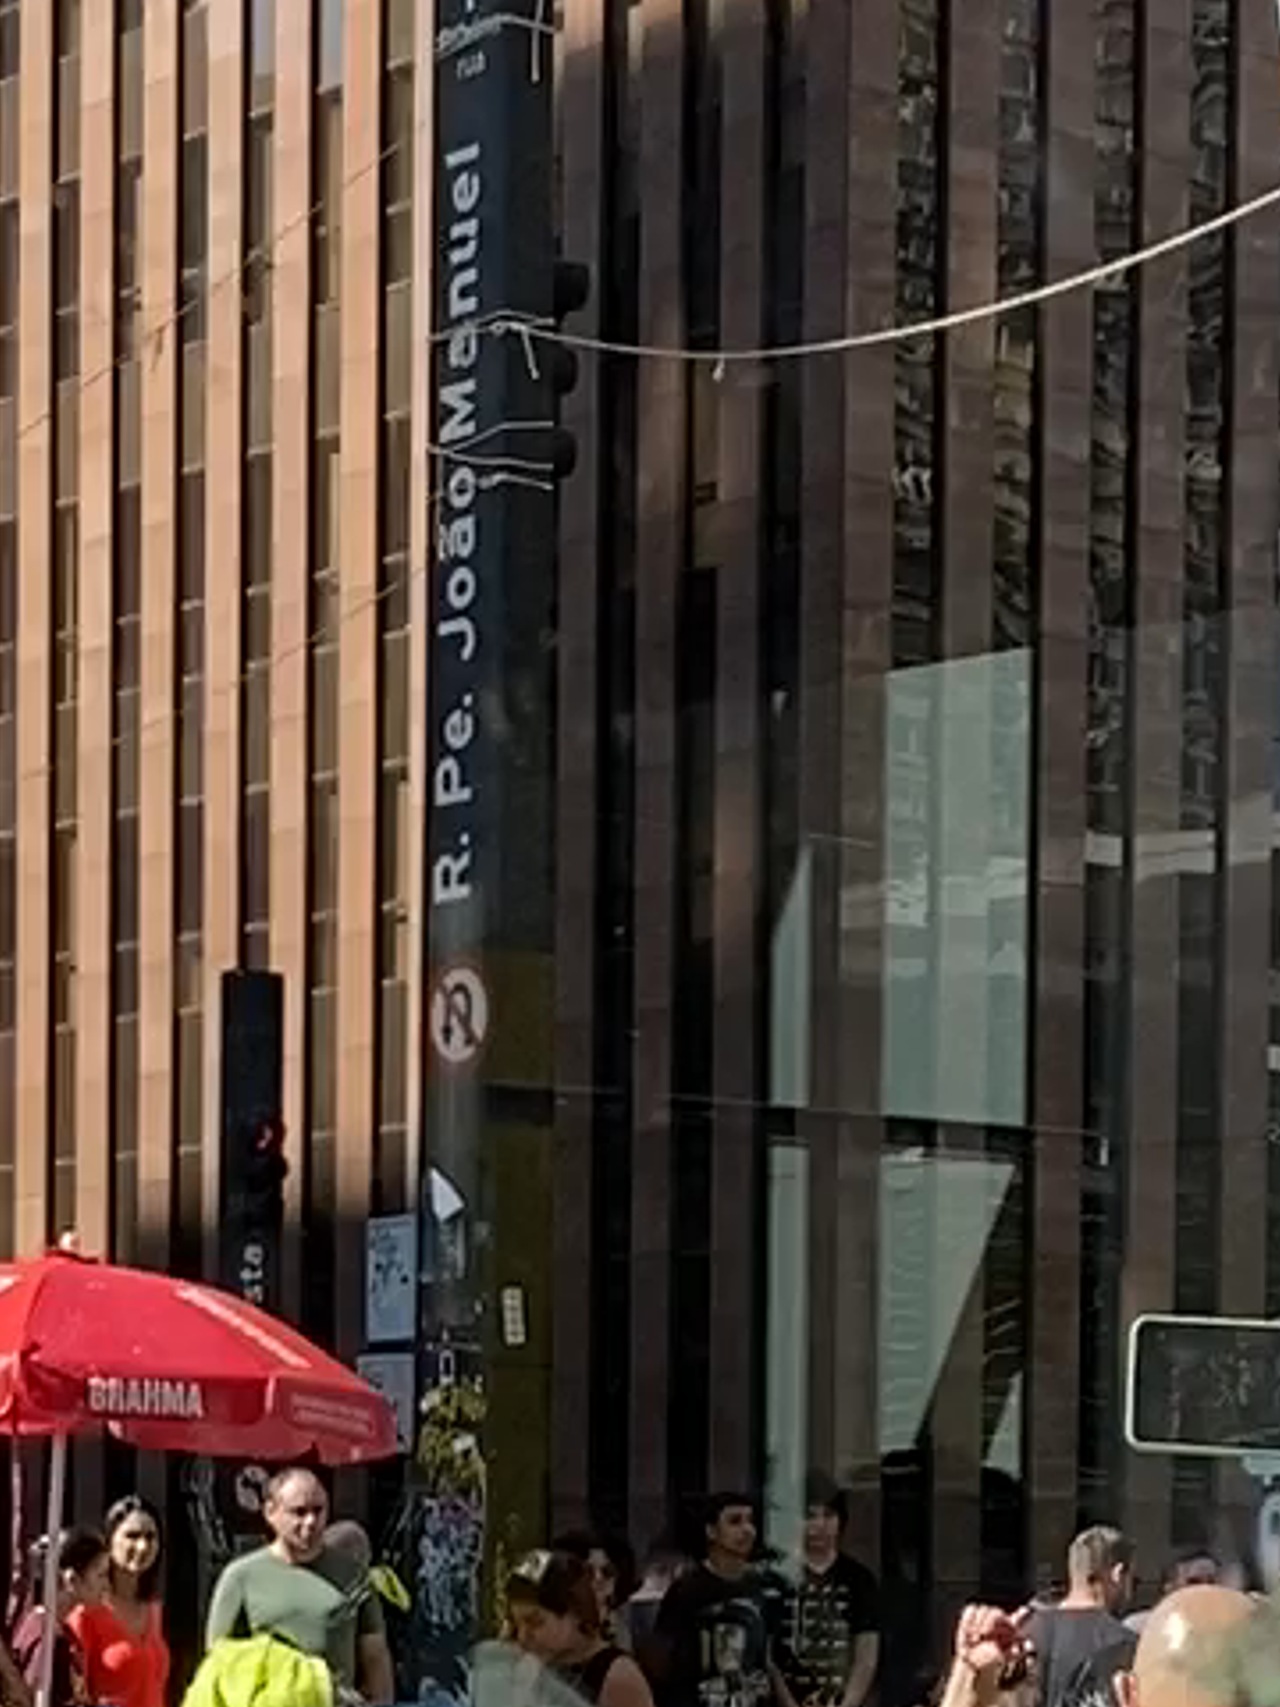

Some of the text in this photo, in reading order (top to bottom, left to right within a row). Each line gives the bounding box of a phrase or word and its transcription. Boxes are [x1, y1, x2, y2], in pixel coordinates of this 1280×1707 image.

[432, 141, 482, 906] R. Pe. João Manuel
[86, 1376, 204, 1419] BRAHMA
